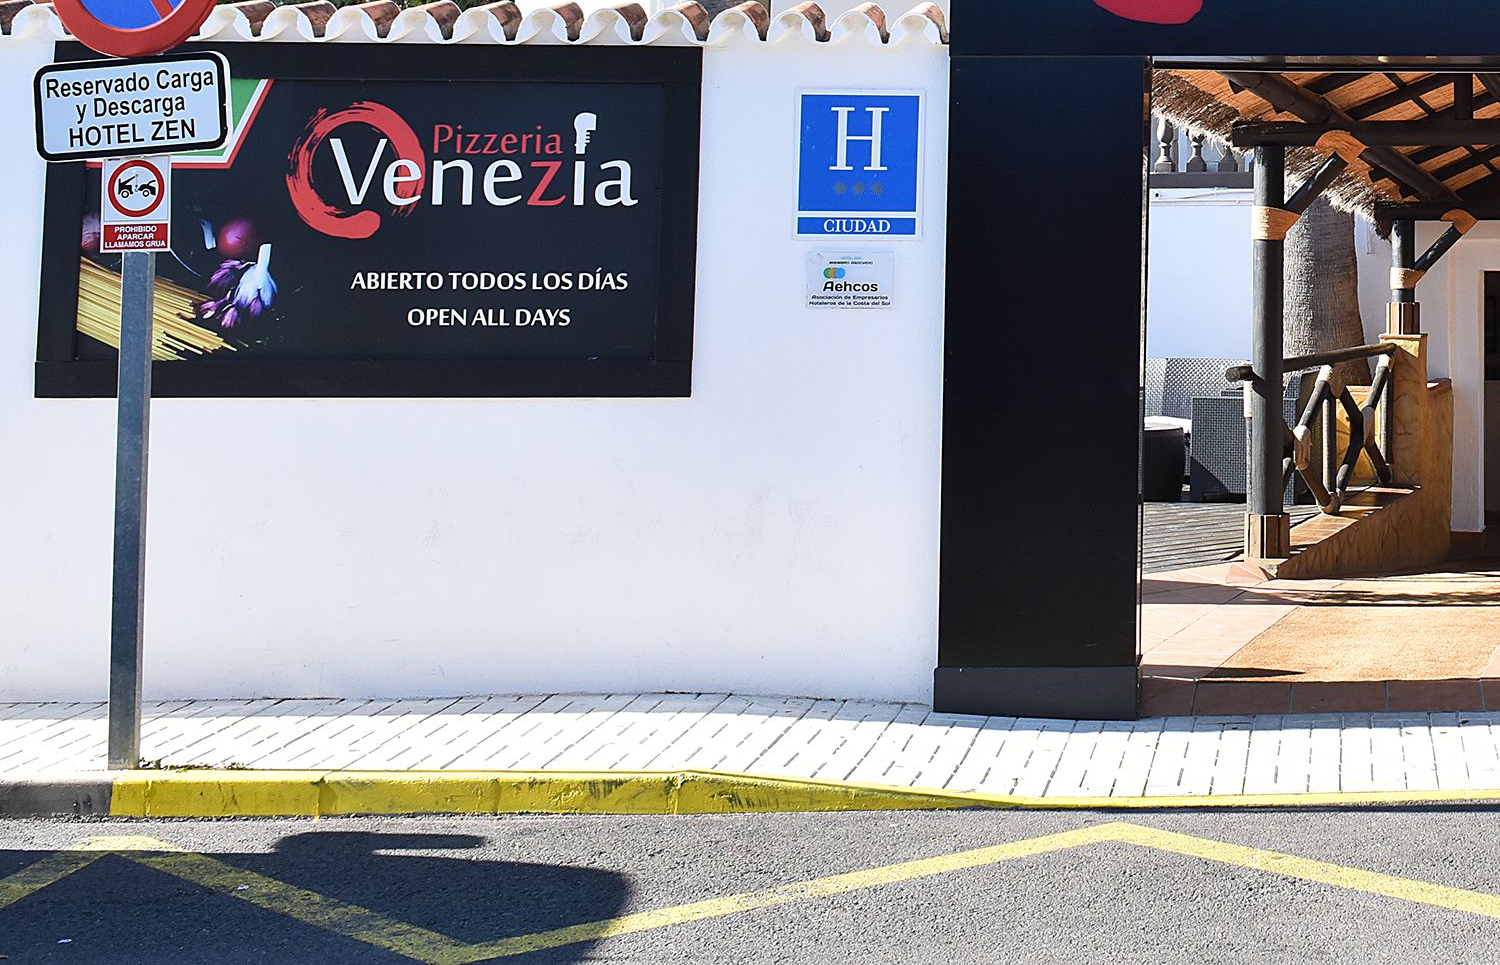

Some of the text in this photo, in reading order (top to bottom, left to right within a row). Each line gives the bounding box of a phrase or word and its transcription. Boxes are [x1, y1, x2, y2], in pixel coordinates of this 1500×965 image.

[46, 69, 214, 98] Reservado Carga
[76, 95, 186, 124] y Descarga
[69, 118, 196, 148] HOTEL ZEN
[432, 123, 564, 155] Pizzeria
[829, 107, 890, 171] H
[329, 137, 640, 207] Venezia
[114, 225, 157, 233] PROHIBIDO
[116, 233, 154, 241] APARCAR
[823, 219, 891, 233] CIUDAD
[104, 241, 144, 249] LLAMAMOS
[351, 267, 628, 290] ABIERTO TODOS LOS DÍAS
[823, 281, 878, 292] Aehcos
[407, 309, 571, 326] OPEN ALL DAYS
